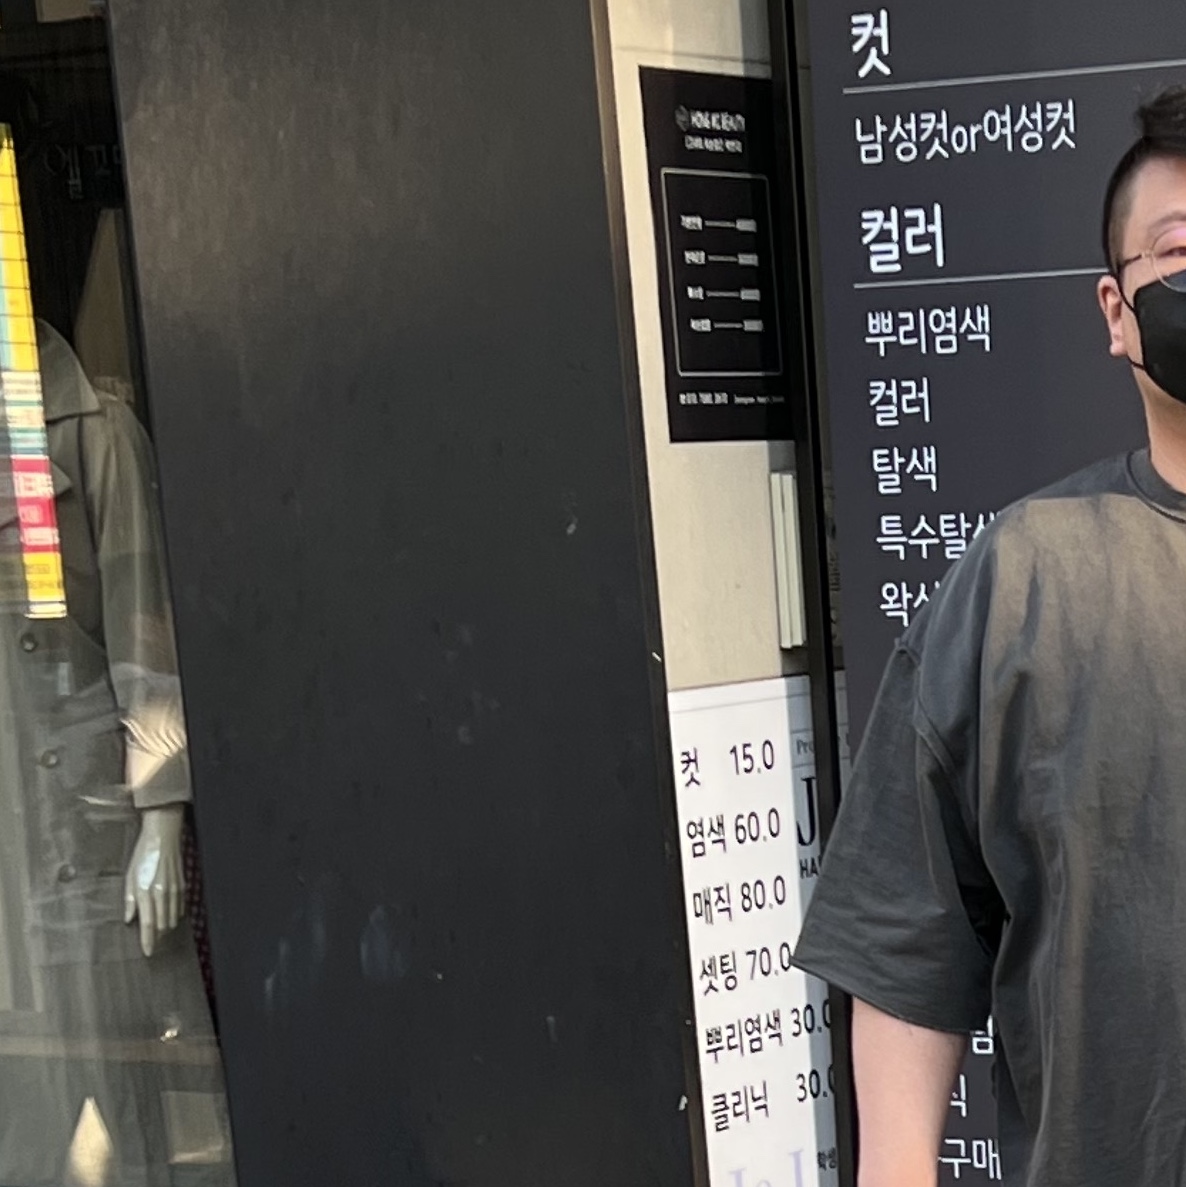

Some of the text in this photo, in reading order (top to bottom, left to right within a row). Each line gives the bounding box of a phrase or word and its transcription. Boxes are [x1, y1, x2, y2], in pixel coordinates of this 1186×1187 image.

[851, 9, 892, 78] 컷
[855, 99, 1076, 164] 남성컷or여성컷
[861, 202, 944, 273] 컬러
[865, 304, 990, 357] 뿌리염색
[869, 376, 931, 427] 컬러
[872, 445, 938, 495] 탈색
[681, 739, 775, 788] 컷 15.0
[686, 807, 781, 858] 염색 60.0
[693, 875, 787, 925] 매직 80.0
[700, 942, 792, 996] 셋팅 70.0
[705, 1008, 783, 1064] 뿌리염색
[711, 1080, 770, 1133] 클리닉
